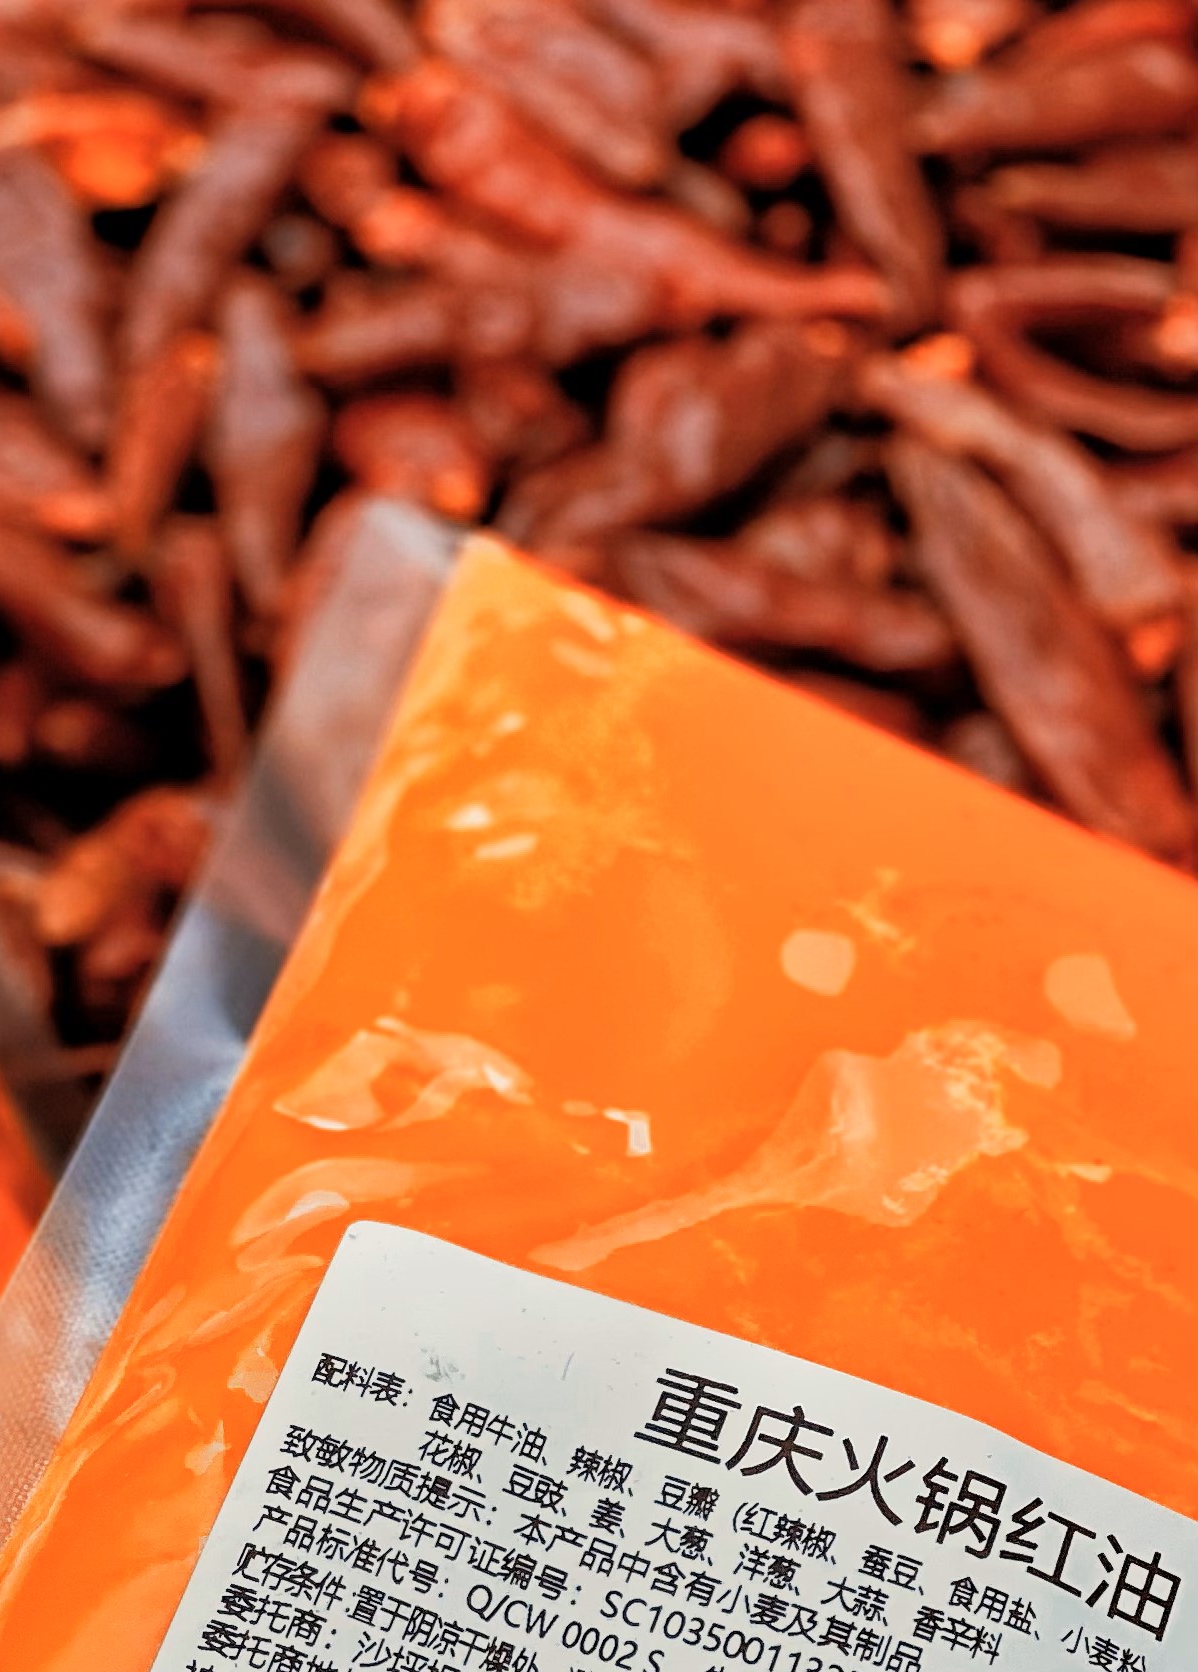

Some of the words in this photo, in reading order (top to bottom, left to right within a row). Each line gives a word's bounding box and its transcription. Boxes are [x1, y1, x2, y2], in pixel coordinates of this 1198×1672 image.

[634, 1368, 1181, 1641] 重庆火锅红油
